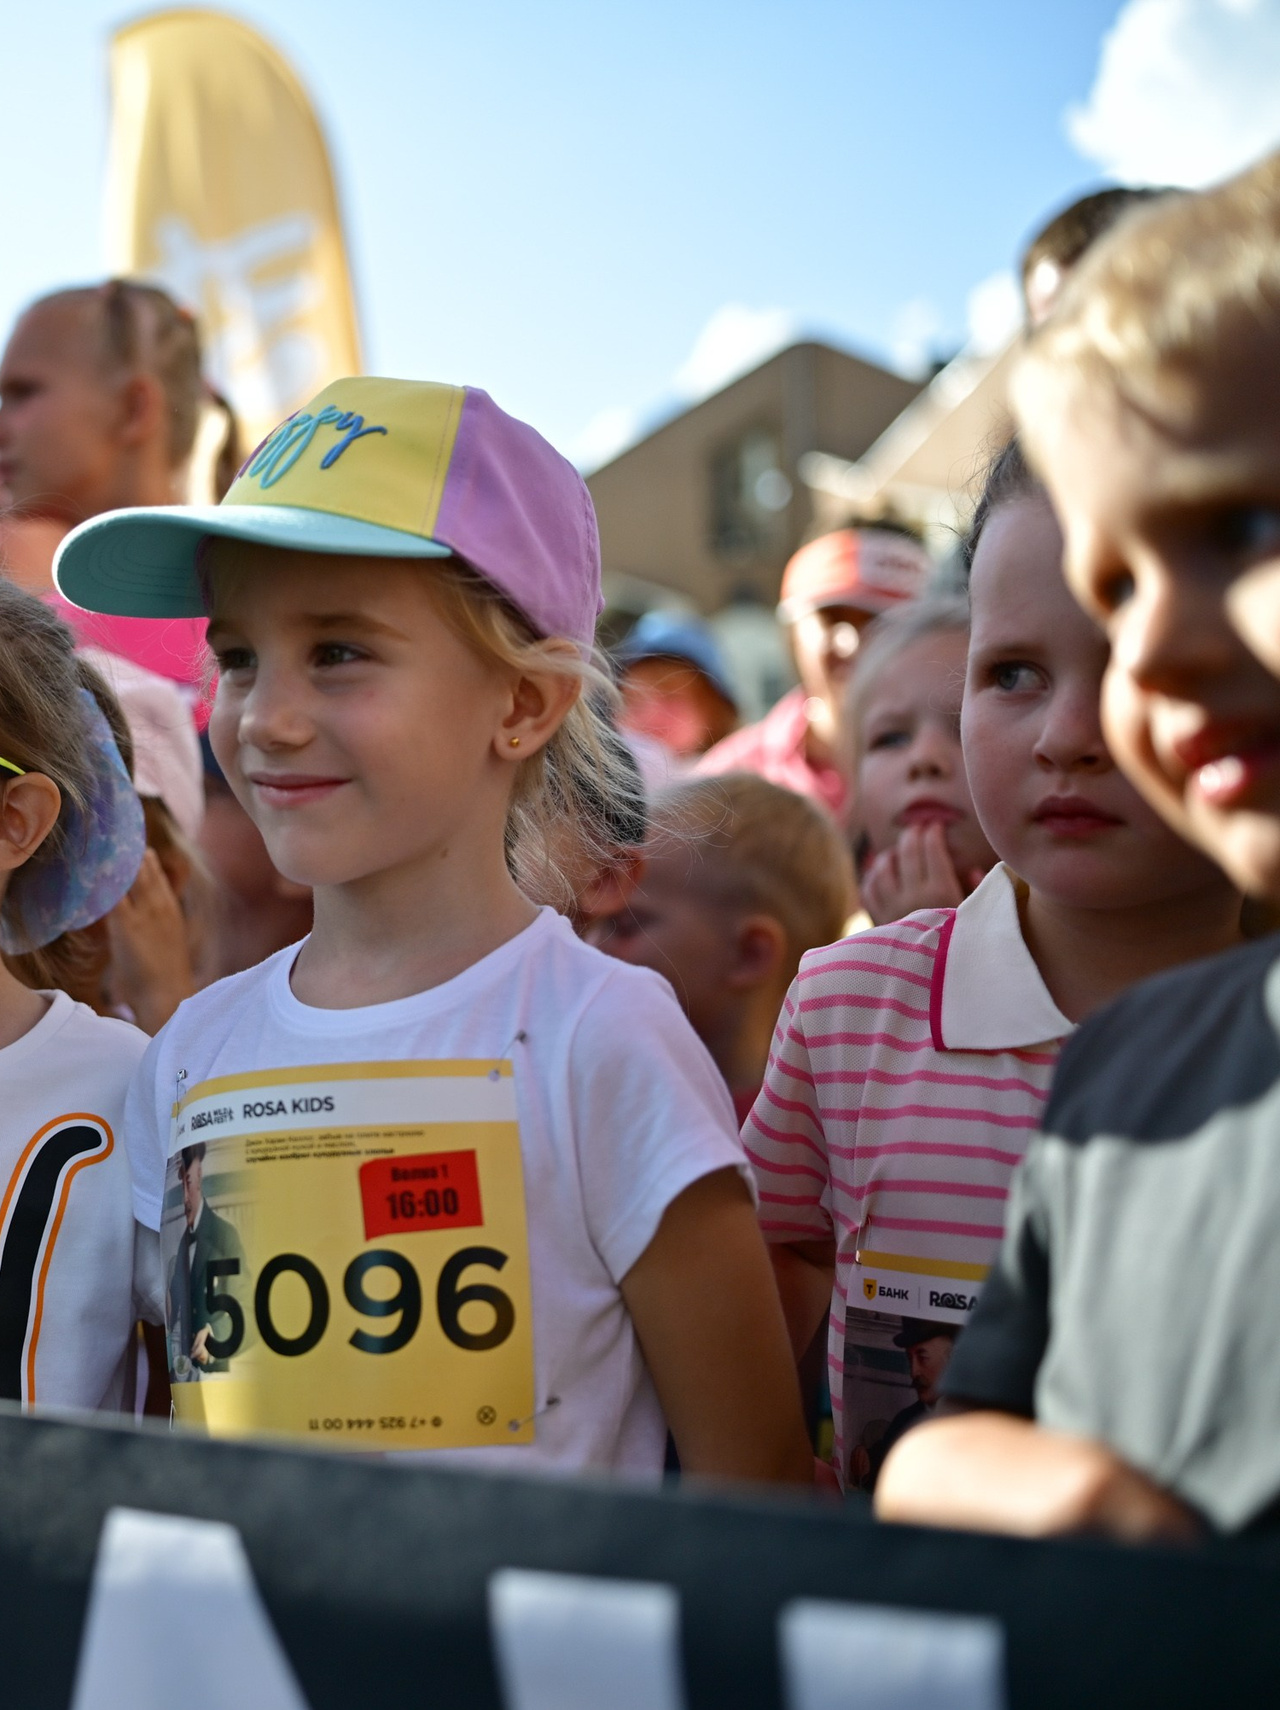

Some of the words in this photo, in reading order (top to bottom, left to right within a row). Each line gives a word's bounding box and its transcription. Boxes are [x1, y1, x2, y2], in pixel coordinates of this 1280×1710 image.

[243, 1101, 287, 1119] ROSA
[292, 1096, 335, 1114] KIDS
[386, 1187, 460, 1220] 16:00
[879, 1286, 909, 1300] БАНК
[203, 1246, 516, 1360] 5096
[322, 1417, 344, 1431] 00
[346, 1417, 375, 1430] 444
[379, 1416, 406, 1430] 925
